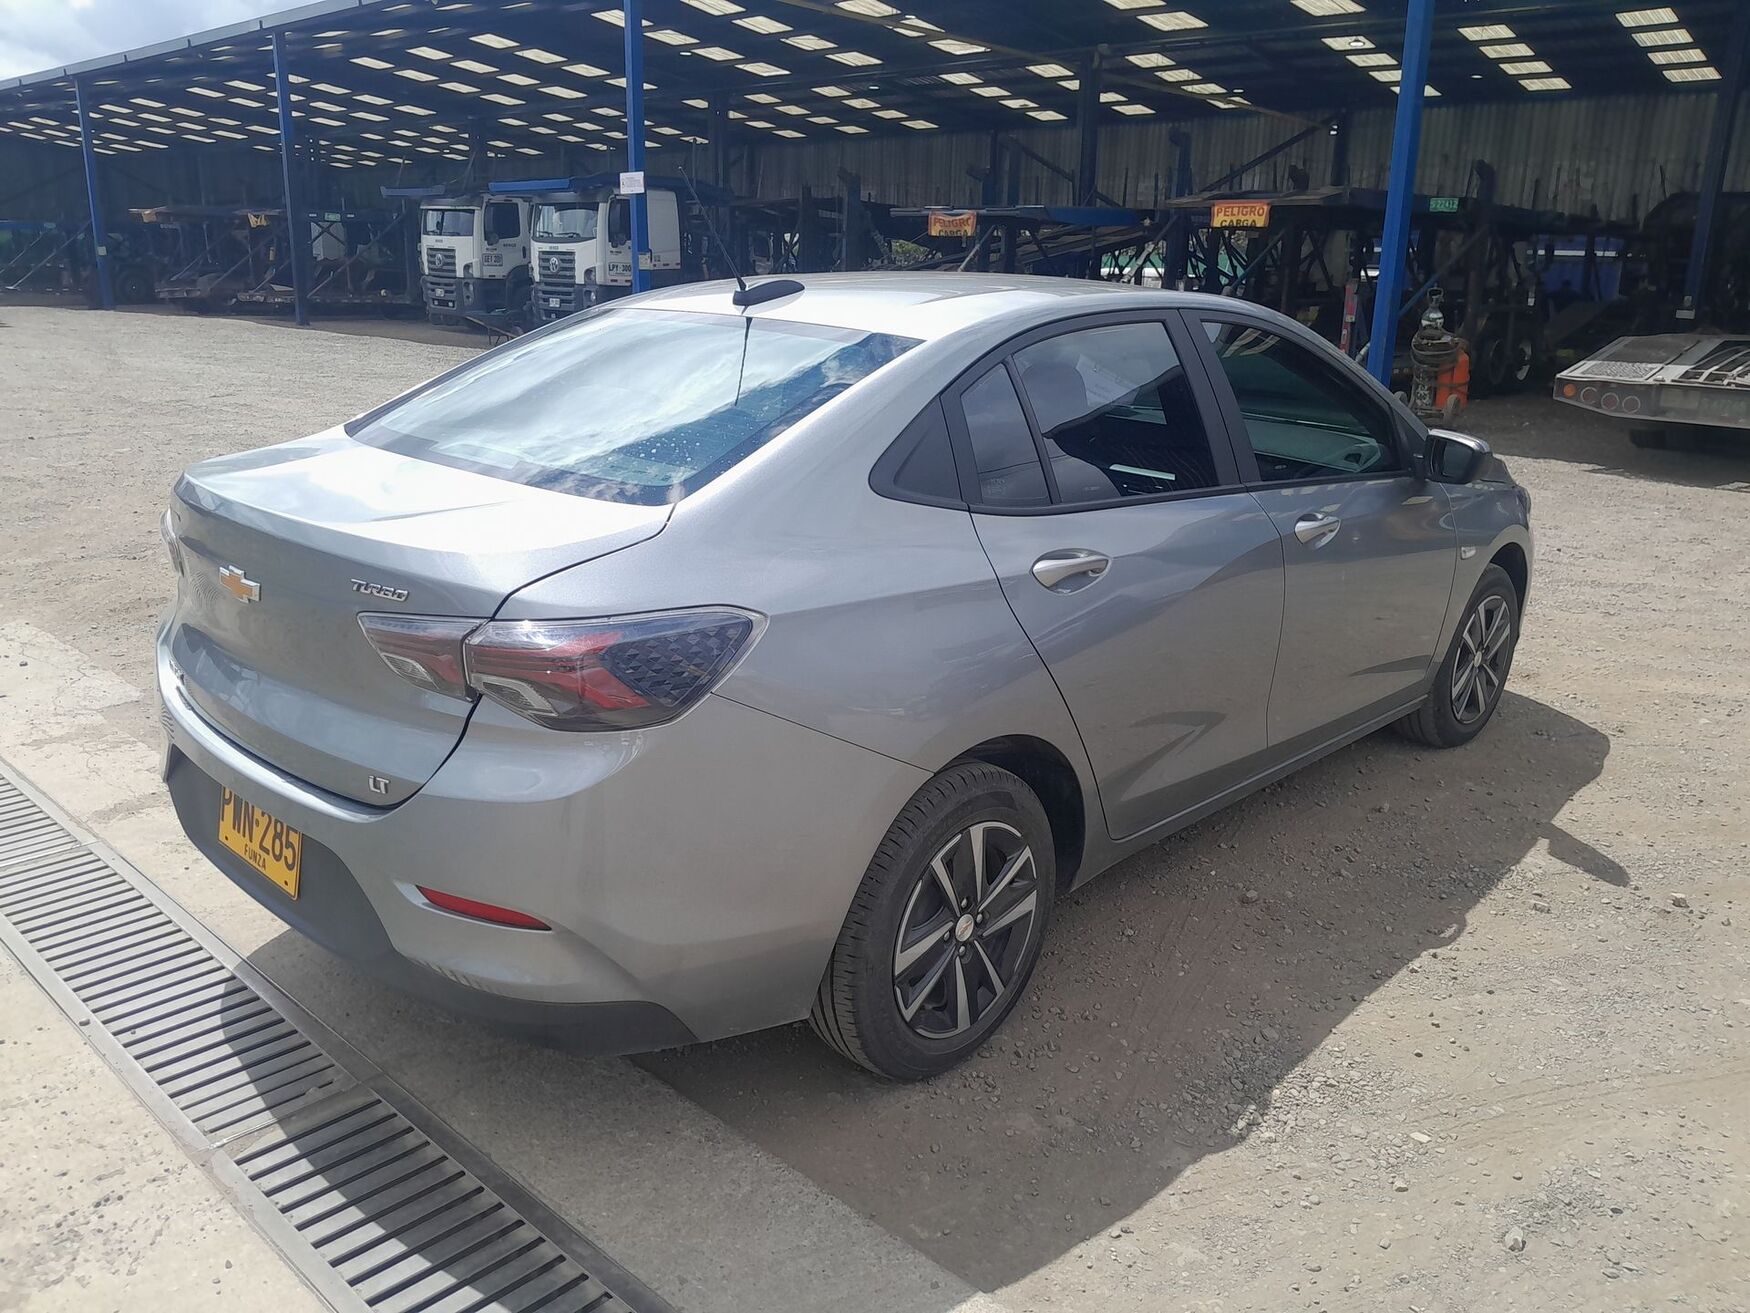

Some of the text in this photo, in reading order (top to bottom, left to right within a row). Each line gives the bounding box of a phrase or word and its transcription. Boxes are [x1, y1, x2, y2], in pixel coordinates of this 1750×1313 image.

[1216, 205, 1265, 217] PELIGRO
[1220, 219, 1257, 228] CARGA
[351, 578, 408, 601] TURBO
[368, 775, 390, 794] LT
[244, 843, 266, 871] FUNZA
